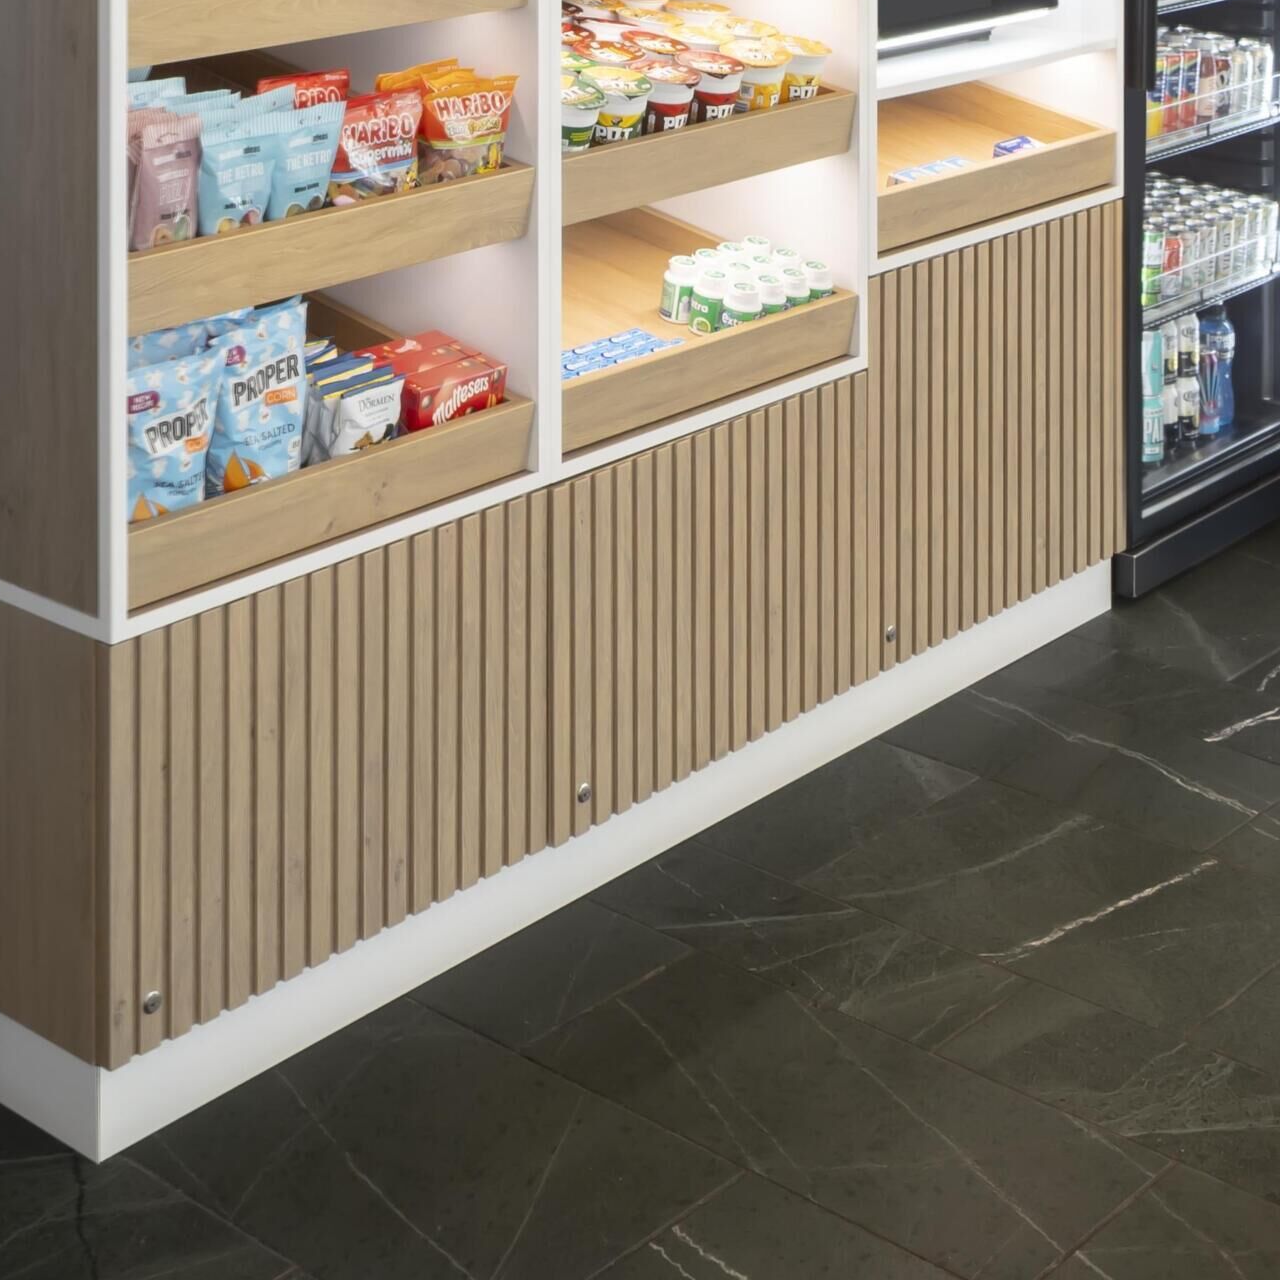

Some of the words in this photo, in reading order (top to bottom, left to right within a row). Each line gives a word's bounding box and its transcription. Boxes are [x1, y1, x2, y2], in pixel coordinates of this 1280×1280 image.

[433, 90, 505, 122] HARIBO
[342, 112, 415, 152] HARIBO
[233, 354, 299, 407] PROPER
[266, 390, 296, 403] CORN
[261, 423, 296, 441] SALTED
